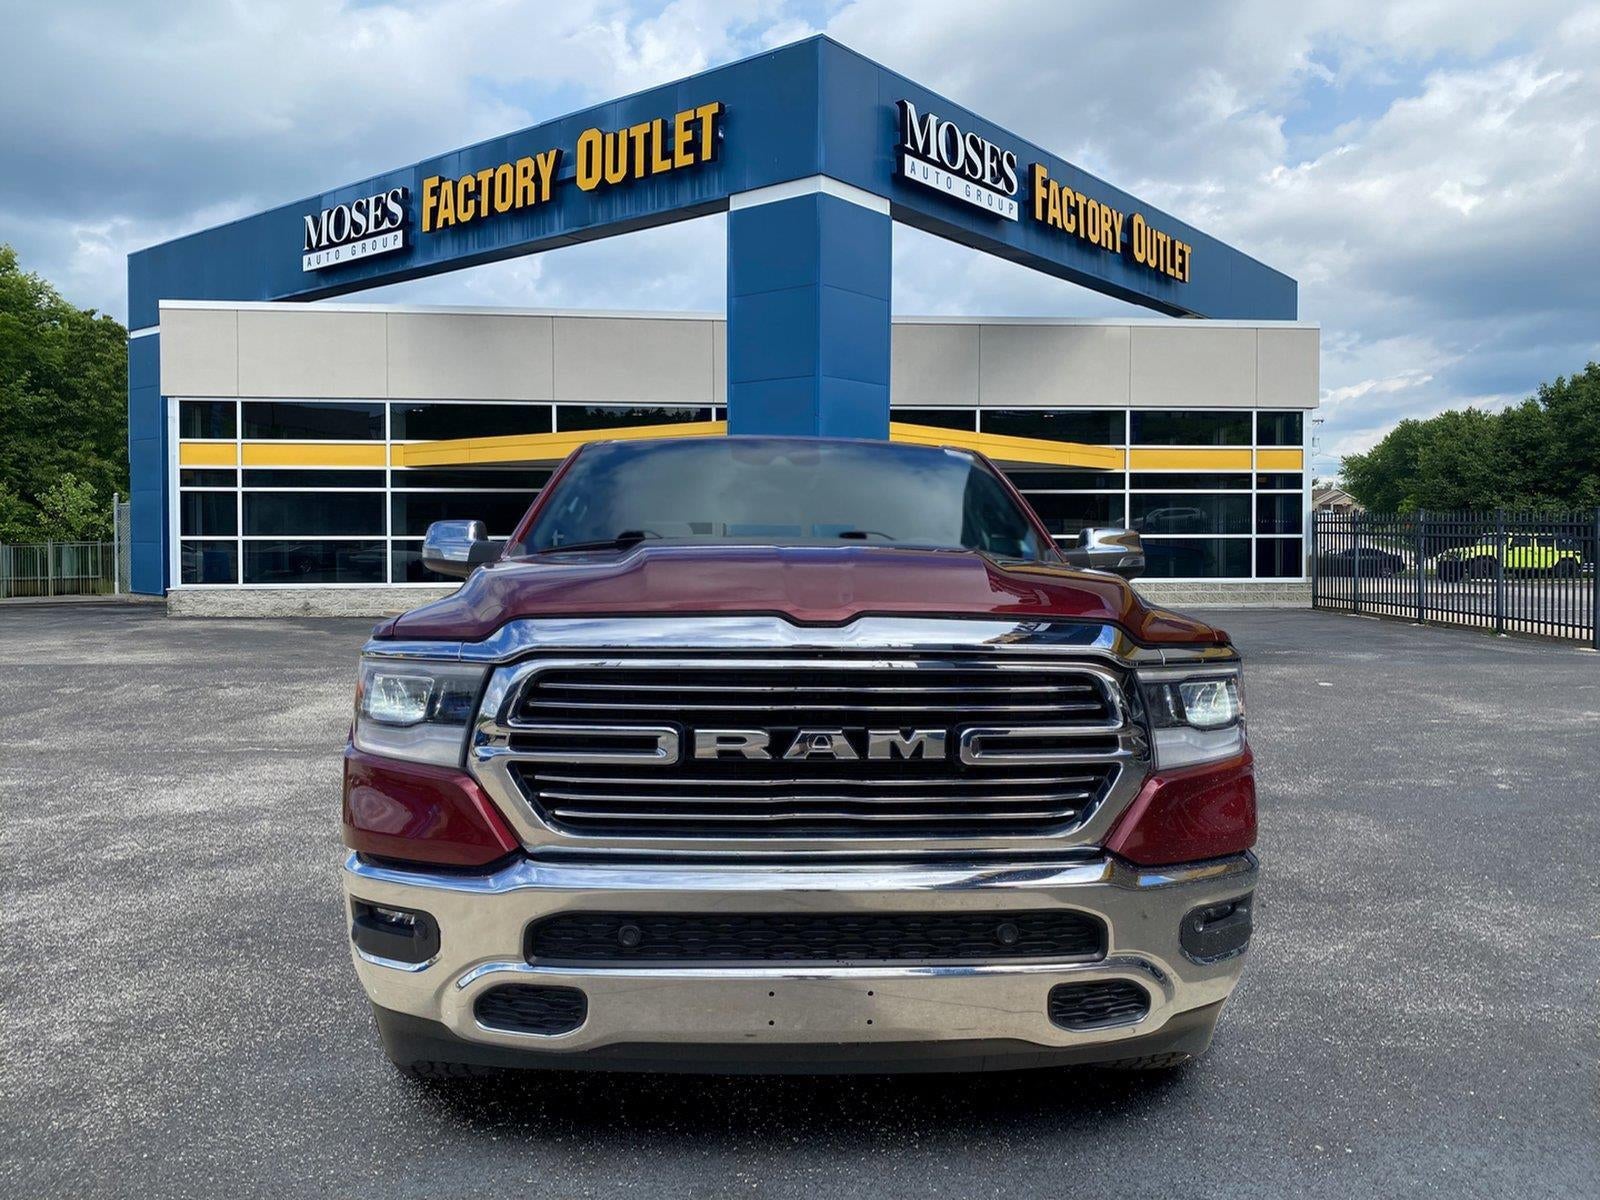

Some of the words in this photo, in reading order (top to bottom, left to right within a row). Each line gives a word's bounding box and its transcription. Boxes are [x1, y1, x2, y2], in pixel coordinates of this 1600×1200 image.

[422, 149, 558, 232] FACTORY
[576, 101, 720, 191] OUTLET
[904, 100, 1018, 196] MOSES
[303, 188, 404, 251] MOSES
[909, 161, 953, 190] AUTO
[965, 178, 1015, 215] GROUP
[306, 249, 341, 268] AUTO
[350, 234, 400, 259] GROUP
[1034, 163, 1124, 254] FACTORY
[1131, 213, 1192, 283] OUTLET
[693, 728, 947, 760] RAM
